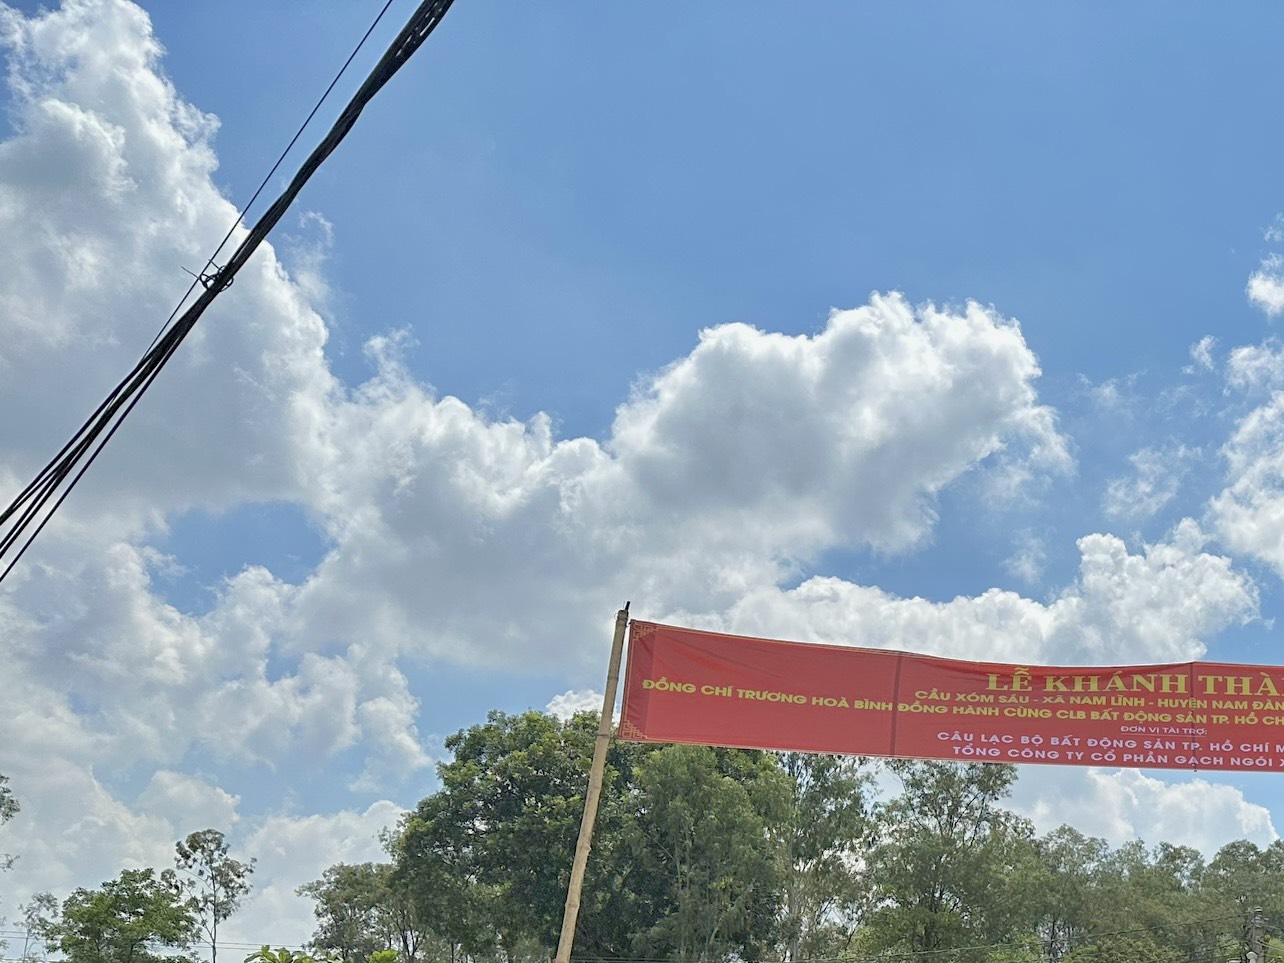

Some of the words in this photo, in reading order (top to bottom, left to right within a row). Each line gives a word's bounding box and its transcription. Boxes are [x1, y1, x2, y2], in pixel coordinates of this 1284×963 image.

[986, 667, 1033, 692] LỄ
[1043, 670, 1189, 694] KHÁNH
[642, 676, 697, 694] ĐỒNG
[700, 685, 733, 698] CHÍ
[736, 688, 807, 705] TRƯƠNG
[812, 696, 849, 708] HOÀ
[854, 699, 893, 711] BÌNH
[897, 700, 948, 714] ĐỒNG
[952, 704, 999, 717] HÀNH
[1003, 706, 1053, 719] CÙNG
[1056, 709, 1087, 720] CLB
[1090, 708, 1119, 721] BẤT
[1123, 710, 1172, 724] ĐỘNG
[1175, 709, 1207, 724] SẢN
[1211, 714, 1230, 724] TP.
[1234, 712, 1259, 725] HỒ
[914, 687, 951, 701] CẦU
[955, 692, 994, 703] XÓM
[998, 693, 1030, 704] SÁU
[1069, 696, 1106, 706] NAM
[1157, 697, 1207, 711] HUYỆN
[1212, 700, 1248, 710] NAM
[937, 730, 974, 742] CÂU
[980, 734, 1014, 745] LẠC
[1020, 734, 1044, 747] BỘ
[1050, 734, 1081, 747] BẤT
[1087, 736, 1137, 750] ĐỘNG
[1143, 738, 1176, 750] SẢN
[1182, 741, 1203, 751] TP.
[1209, 739, 1233, 752] HỒ
[1239, 742, 1270, 753] CHÍ
[1121, 725, 1146, 734] ĐƠN
[1149, 726, 1160, 735] VỊ
[1163, 725, 1181, 735] TÀI
[953, 743, 1001, 757] TỔNG
[1007, 748, 1060, 760] CÔNG
[1066, 751, 1084, 761] TY
[1090, 750, 1117, 762] CỔ
[1123, 751, 1168, 764] PHẦN
[1174, 755, 1224, 767] GẠCH
[1230, 756, 1273, 768] NGÓI
